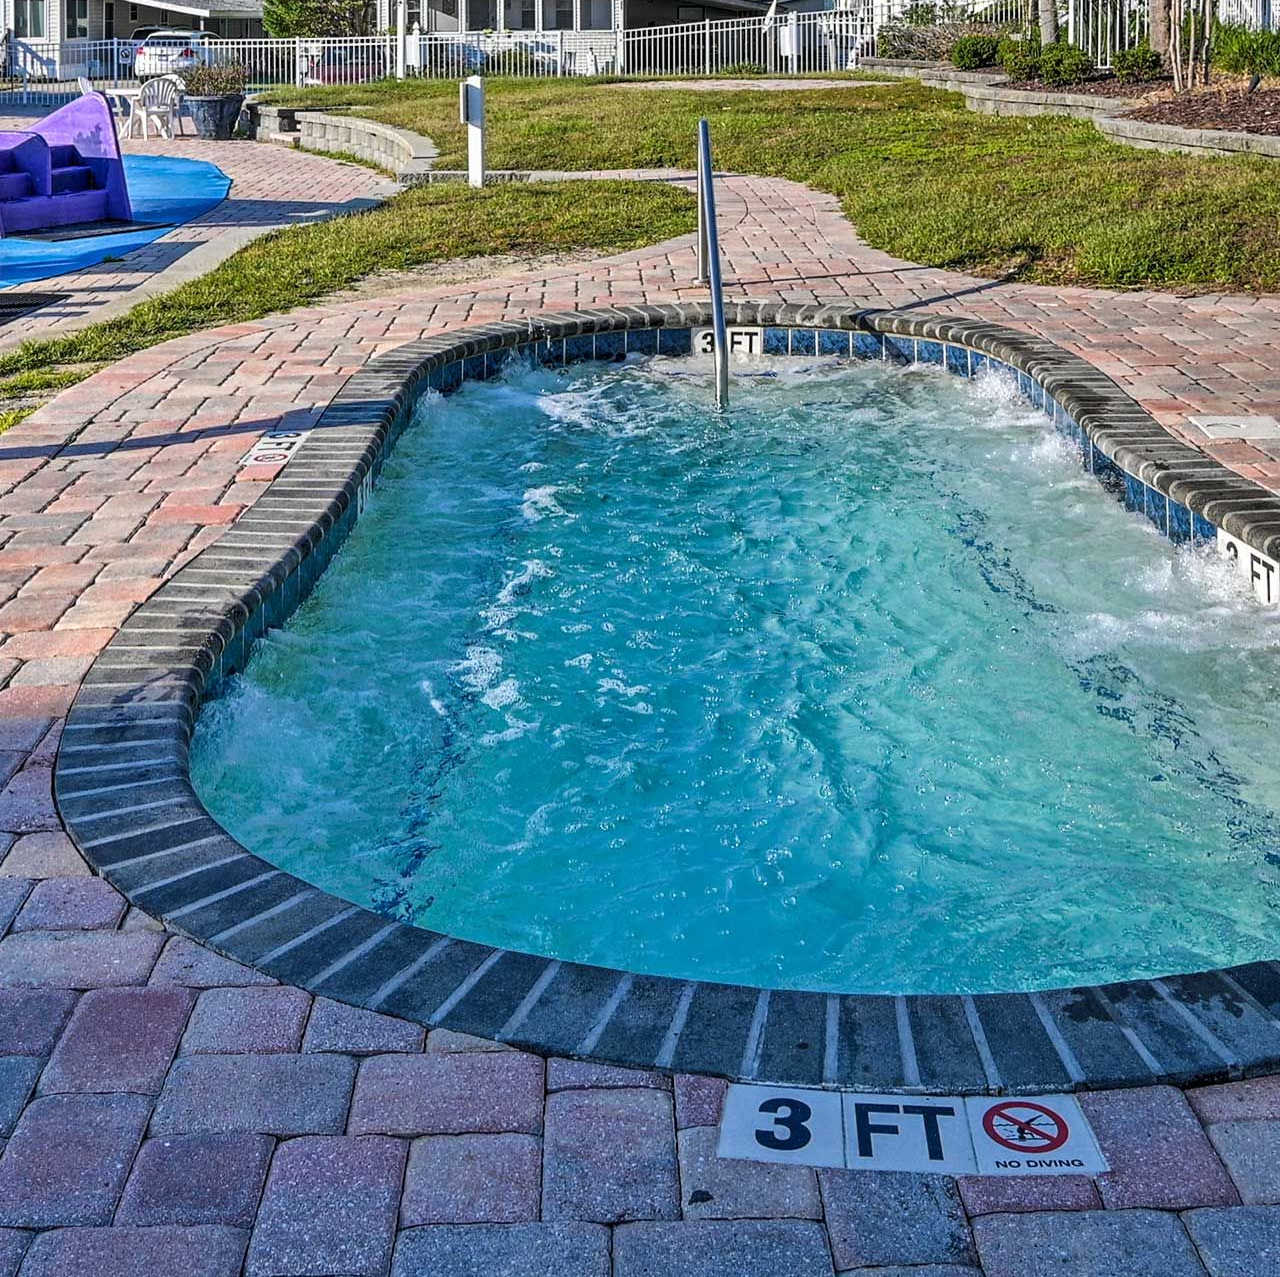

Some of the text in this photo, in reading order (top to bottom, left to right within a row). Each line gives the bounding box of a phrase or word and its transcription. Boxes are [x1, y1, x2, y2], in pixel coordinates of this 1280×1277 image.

[702, 331, 759, 354] 3 FT
[1250, 553, 1274, 604] FT
[755, 1097, 955, 1161] 3 FT
[995, 1159, 1085, 1169] NO DIVING
